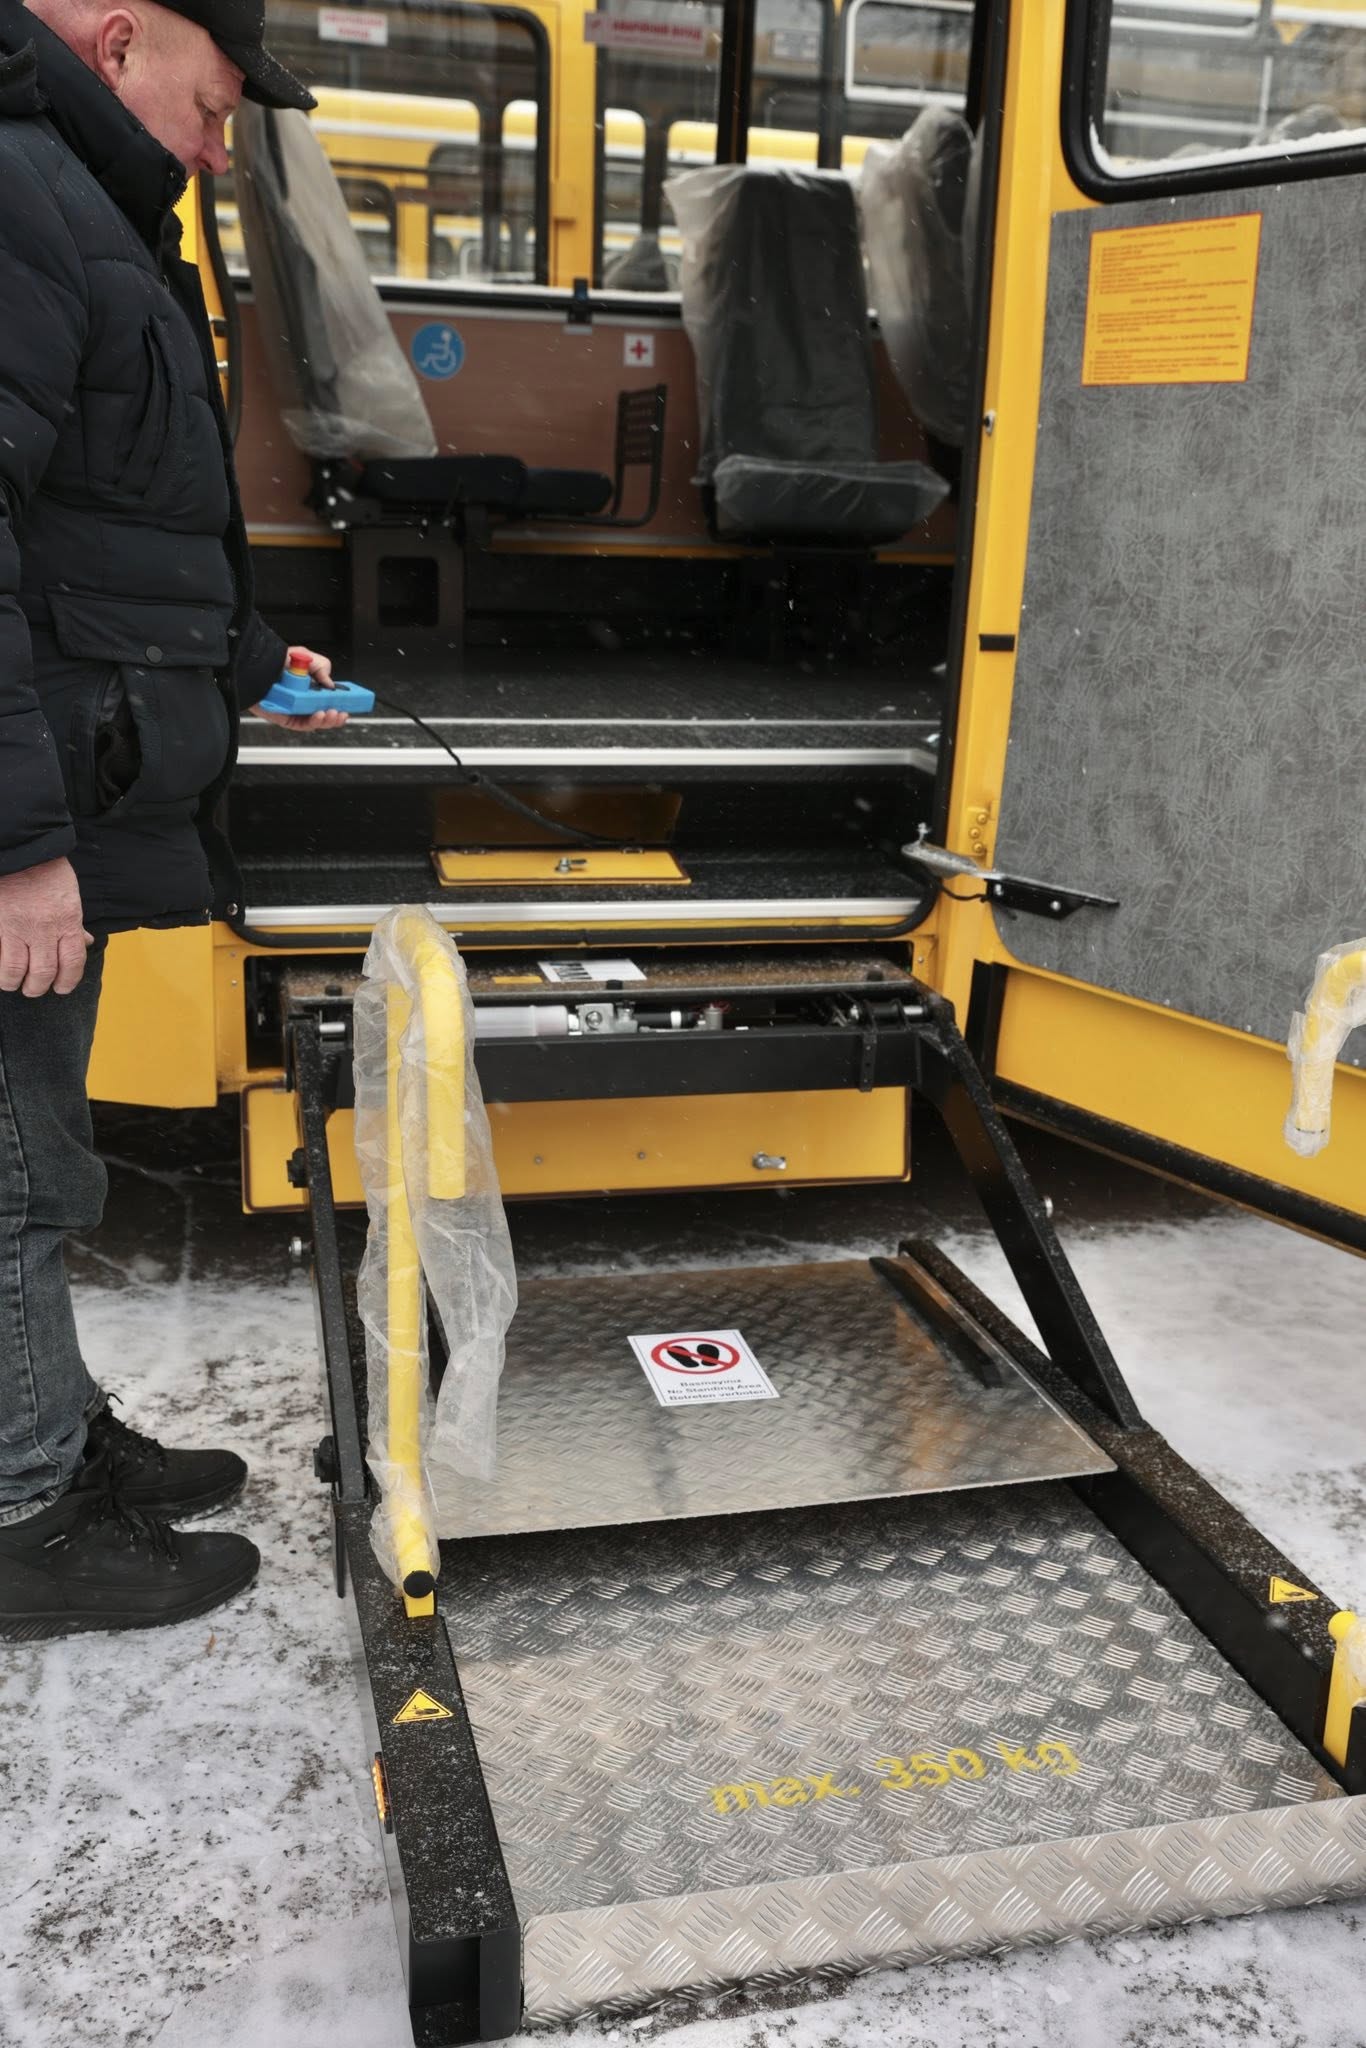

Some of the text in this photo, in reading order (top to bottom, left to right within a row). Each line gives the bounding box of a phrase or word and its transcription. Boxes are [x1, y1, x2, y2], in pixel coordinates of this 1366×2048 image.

[669, 1389, 767, 1401] Betreten verboten
[685, 1385, 735, 1393] Standing
[709, 1740, 1082, 1814] max. 350 kg
